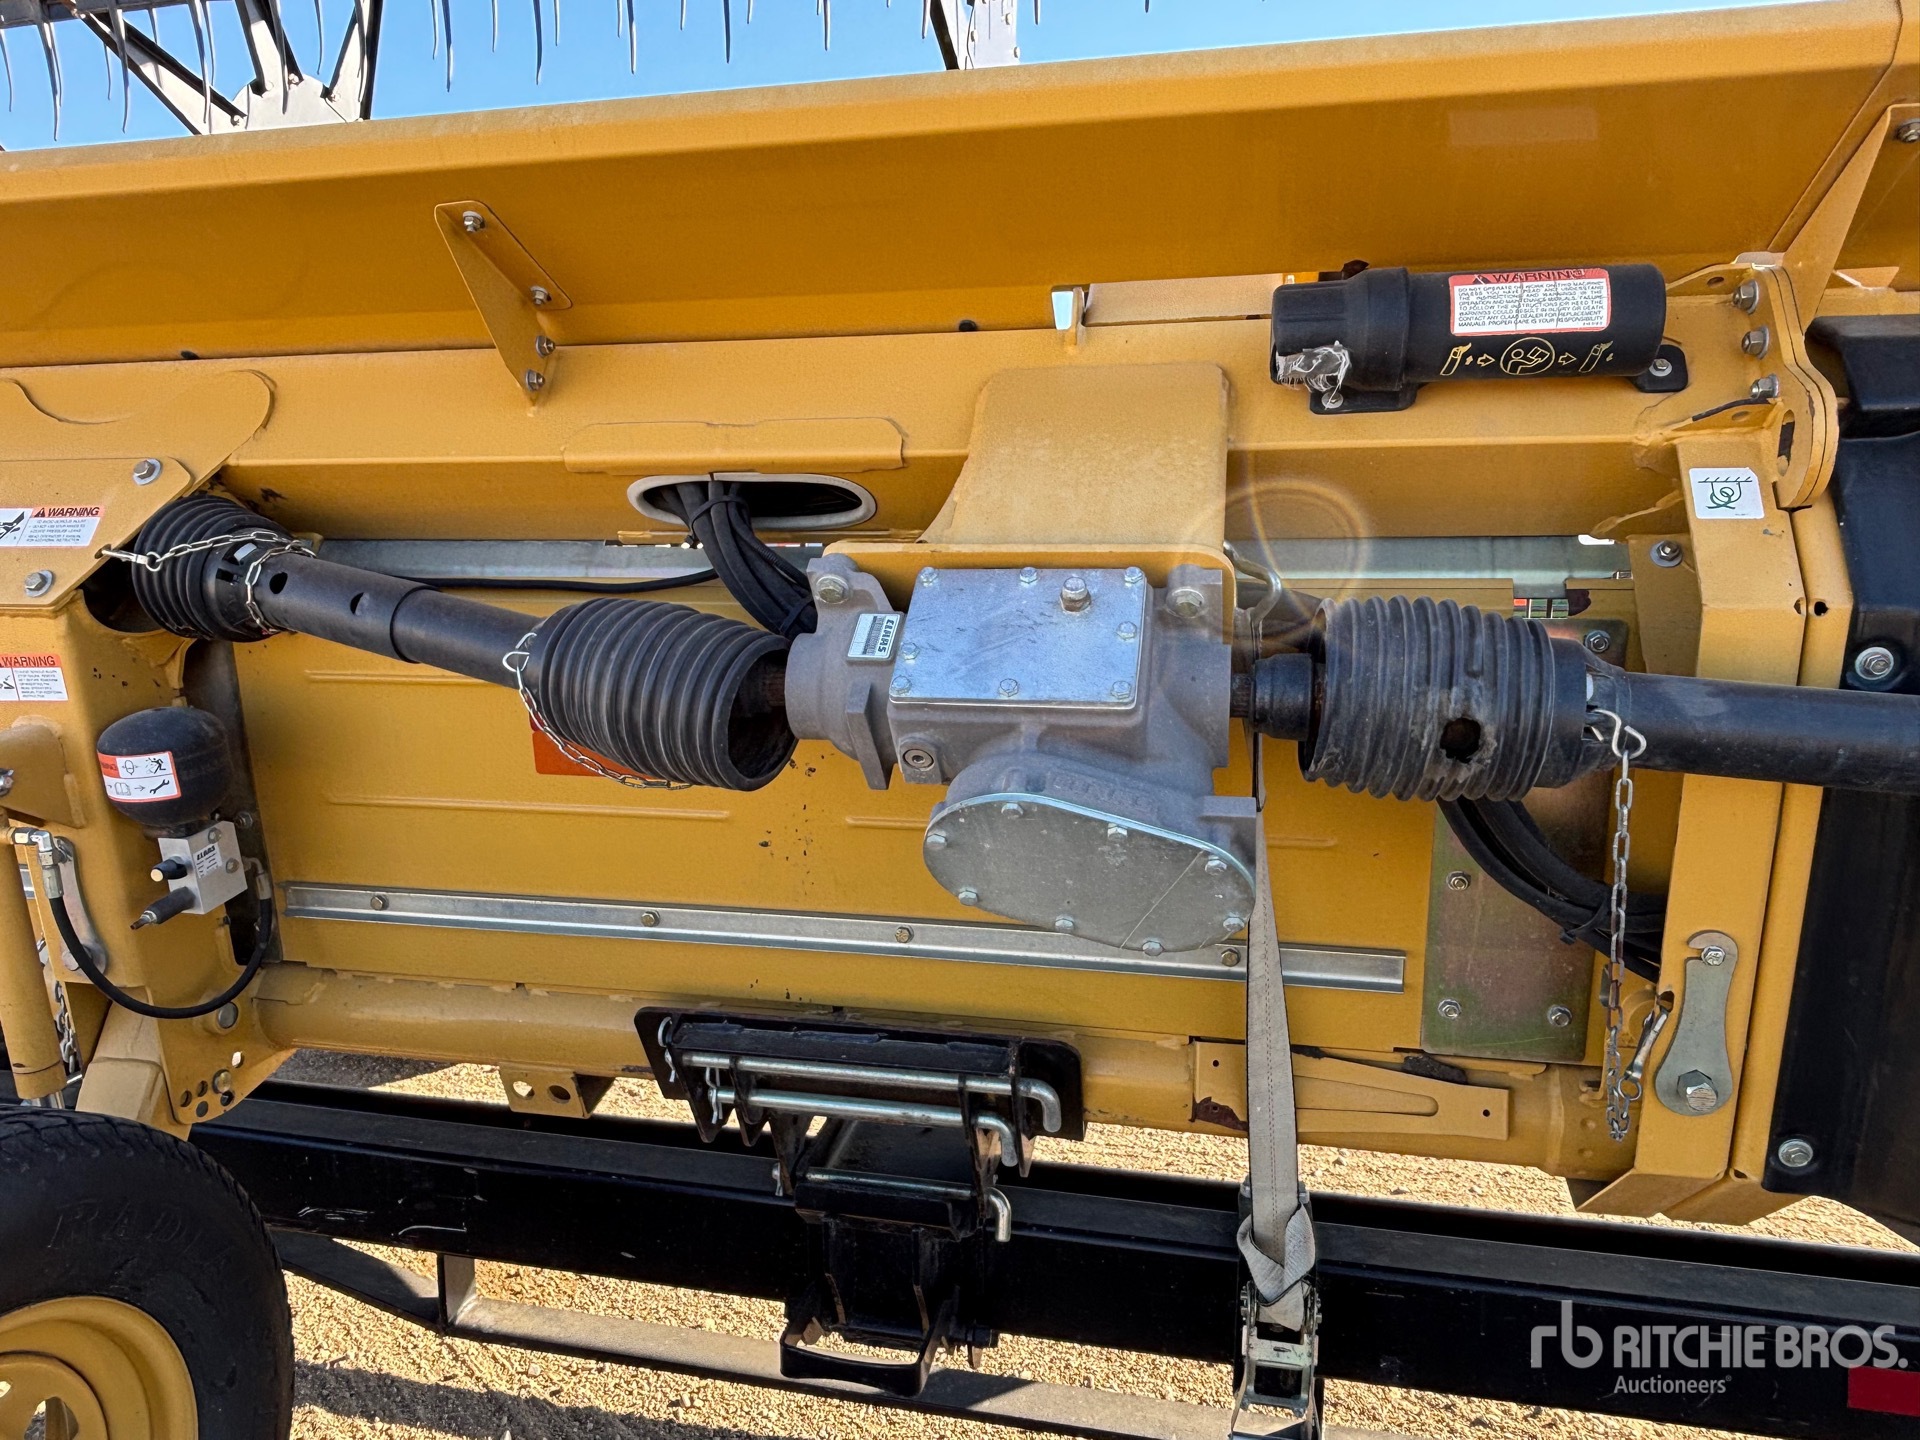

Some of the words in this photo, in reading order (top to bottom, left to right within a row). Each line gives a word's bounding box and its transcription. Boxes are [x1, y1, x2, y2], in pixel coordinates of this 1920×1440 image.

[1492, 269, 1585, 282] WARNING
[48, 506, 100, 516] WARNING
[2, 656, 56, 667] WARNING
